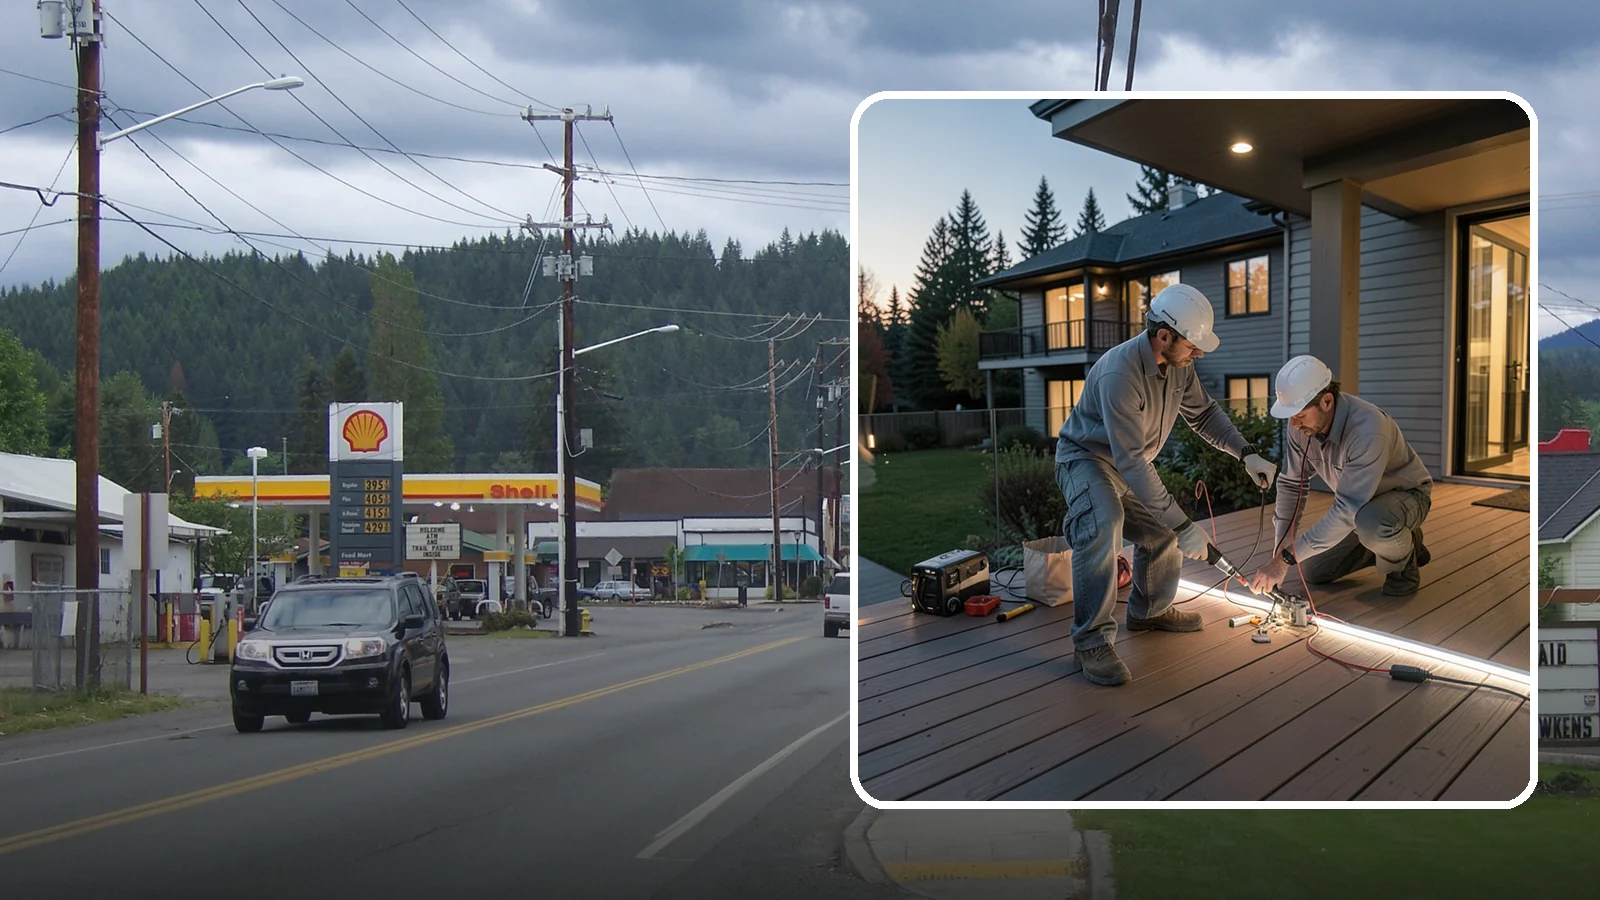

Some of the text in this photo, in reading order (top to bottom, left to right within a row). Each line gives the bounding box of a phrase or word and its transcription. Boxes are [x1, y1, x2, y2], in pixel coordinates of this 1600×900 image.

[366, 480, 384, 490] 395
[490, 484, 548, 499] Shell
[366, 494, 384, 504] 405
[366, 508, 384, 518] 415
[366, 522, 384, 532] 429
